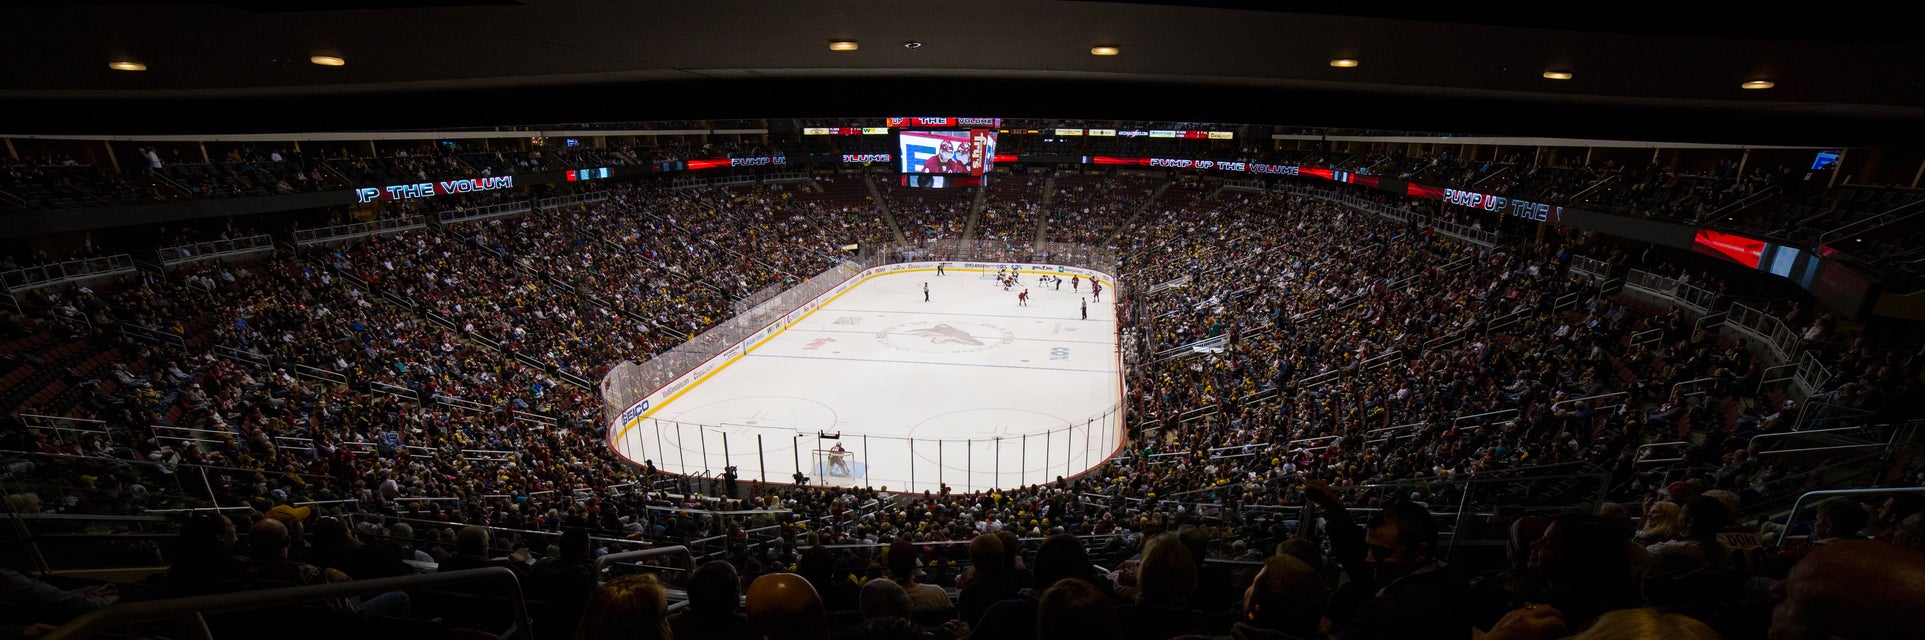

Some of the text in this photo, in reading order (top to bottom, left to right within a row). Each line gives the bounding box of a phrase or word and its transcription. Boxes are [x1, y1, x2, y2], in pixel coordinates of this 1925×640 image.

[919, 117, 947, 125] THE
[958, 117, 993, 125] VOLUME
[731, 156, 771, 167] PUMP
[1150, 158, 1299, 176] PUMP UP THE VOLUME
[386, 182, 435, 201] THE
[441, 175, 514, 194] VOLUM
[1443, 188, 1482, 208] PUMP
[1484, 194, 1508, 213] UP
[1512, 199, 1550, 223] THE
[621, 399, 650, 427] GEICO
